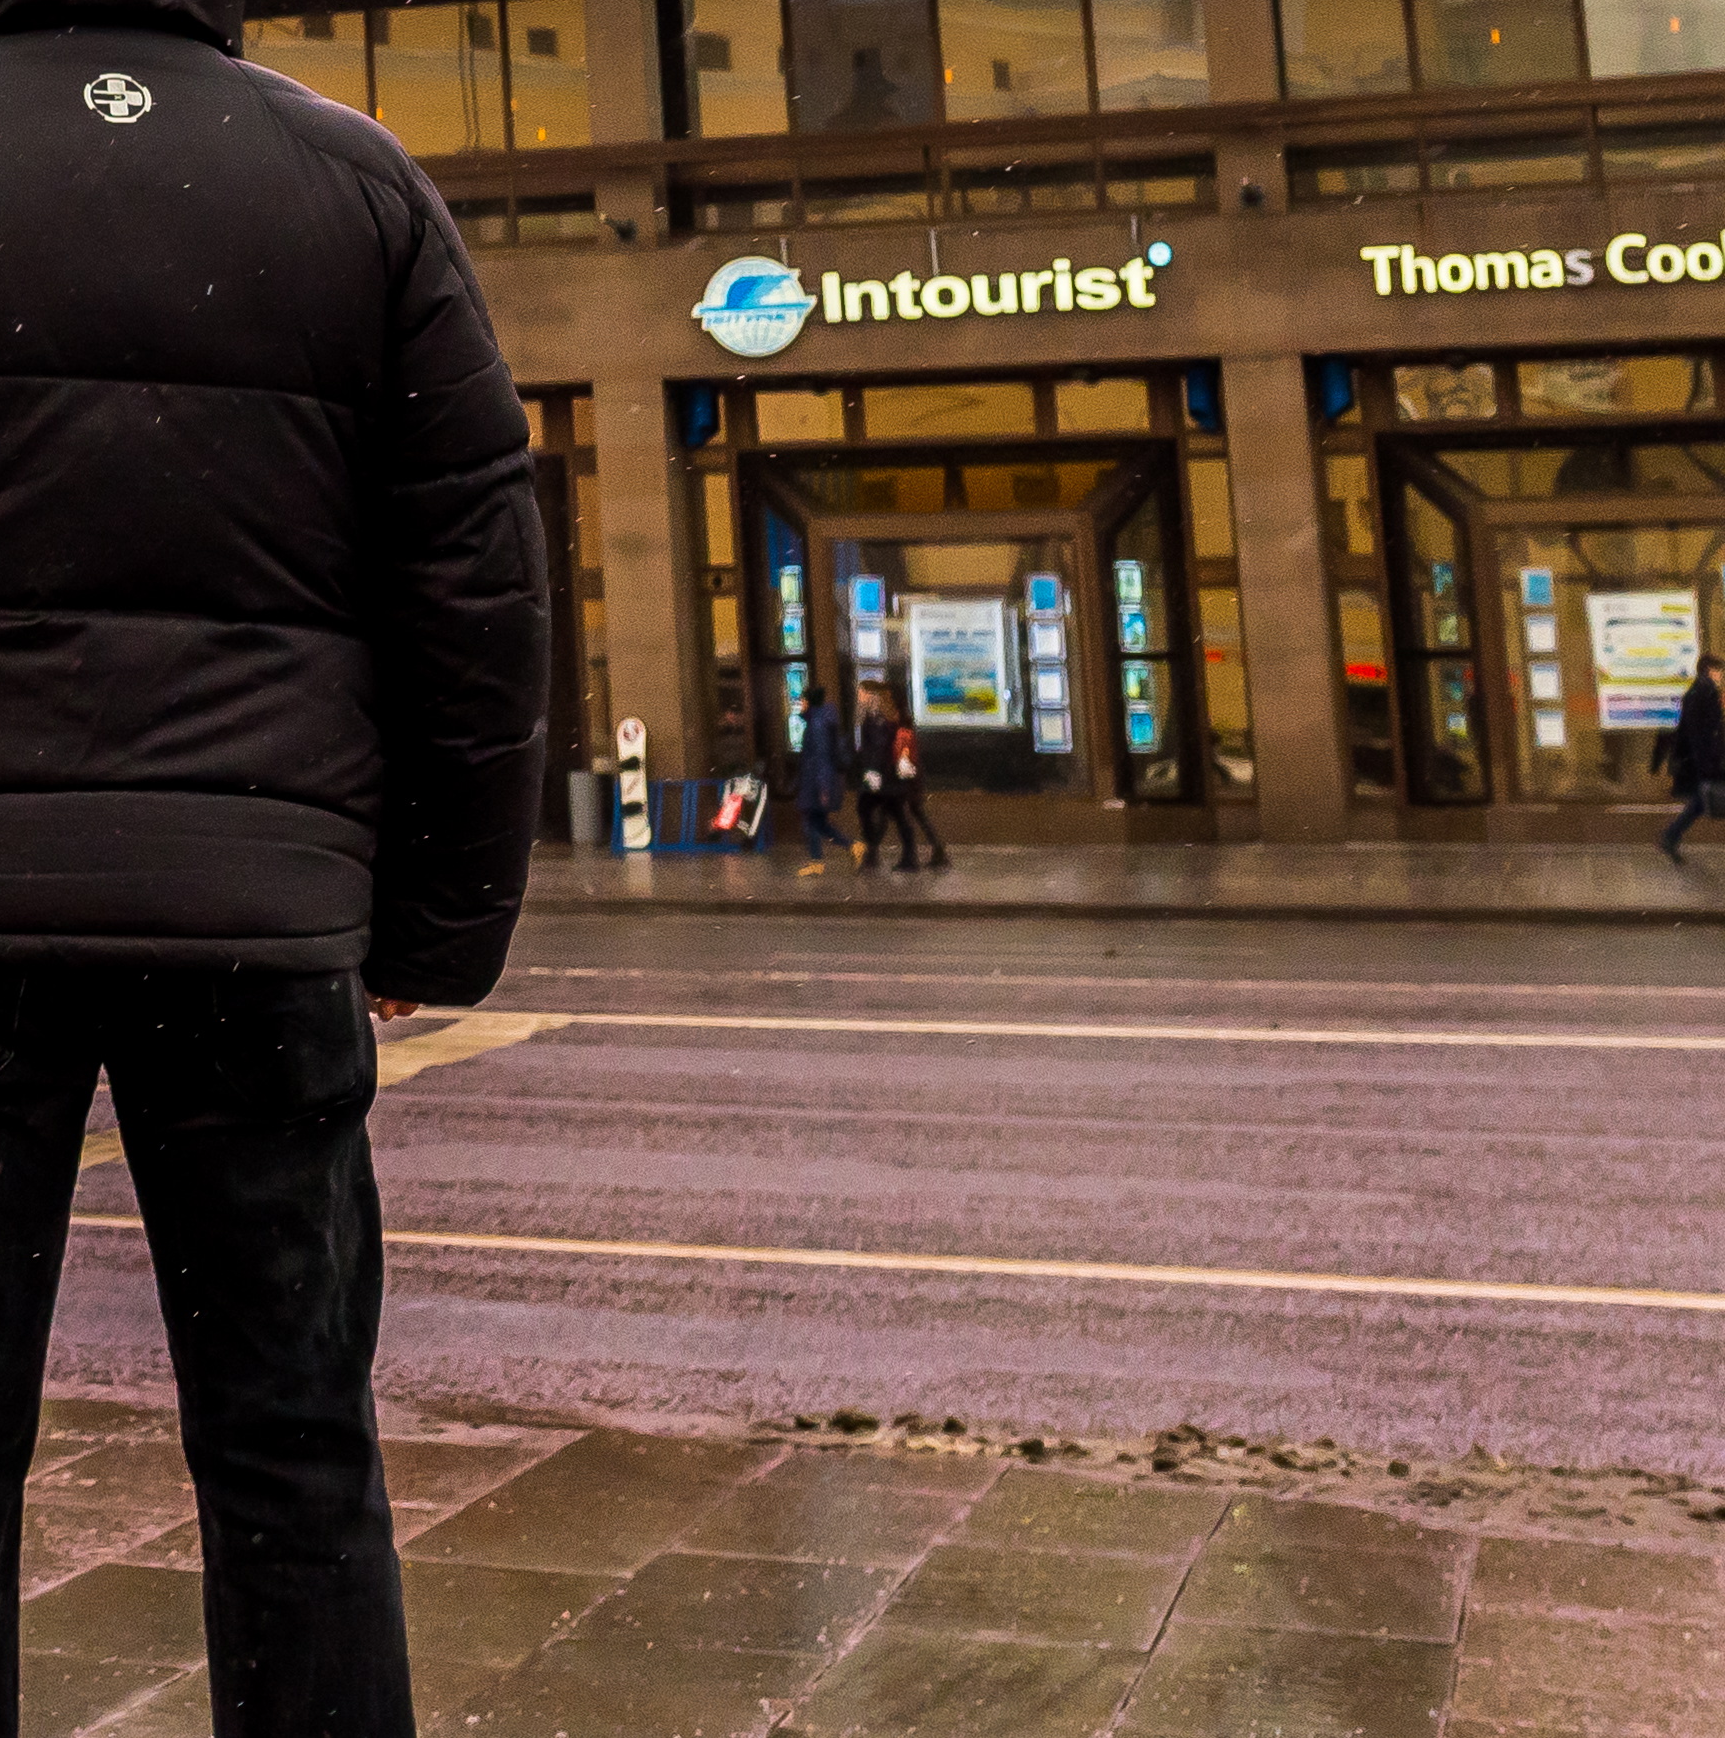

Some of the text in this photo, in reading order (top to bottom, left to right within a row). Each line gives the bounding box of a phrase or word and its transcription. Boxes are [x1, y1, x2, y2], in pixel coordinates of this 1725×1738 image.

[820, 257, 1158, 324] Intourist
[1360, 228, 1725, 296] Thomas Coo
